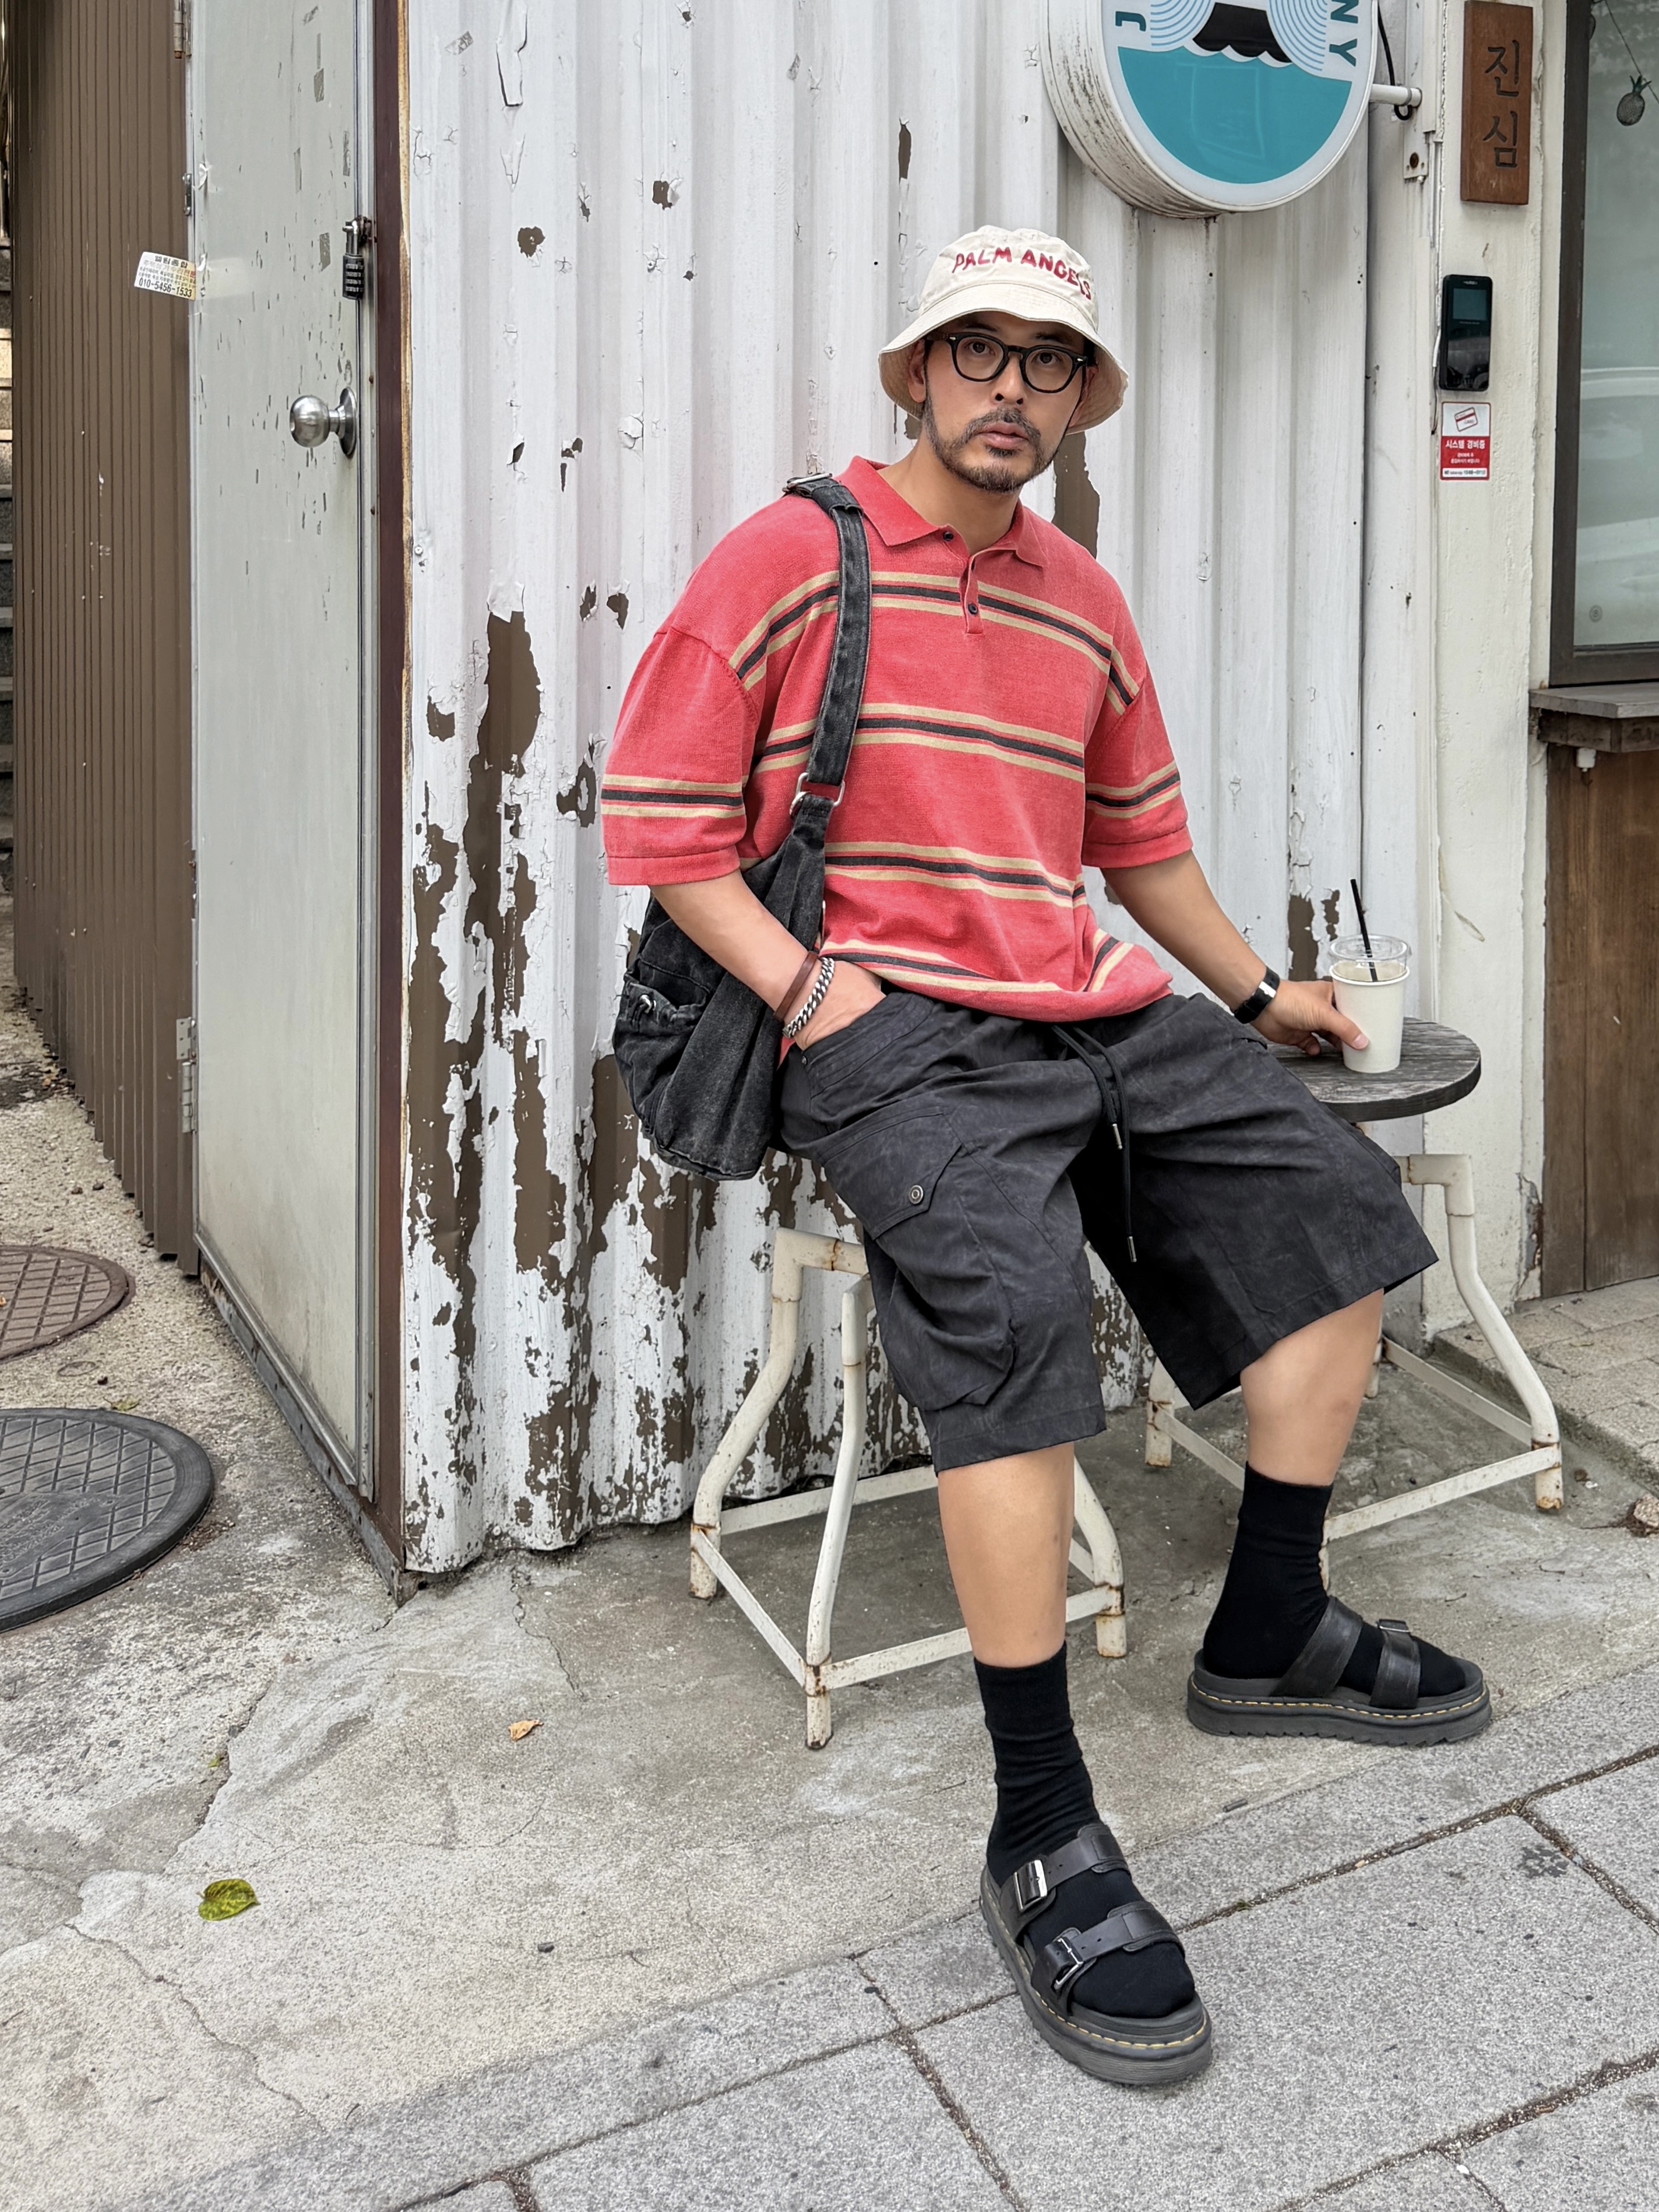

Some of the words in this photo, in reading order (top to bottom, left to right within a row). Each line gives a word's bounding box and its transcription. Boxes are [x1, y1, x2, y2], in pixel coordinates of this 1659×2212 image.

[1483, 39, 1520, 168] 진심
[952, 247, 1012, 273] PALM
[139, 278, 192, 297] 010-5456-1533
[1445, 439, 1465, 449] 시스템
[1467, 439, 1485, 449] 경비중
